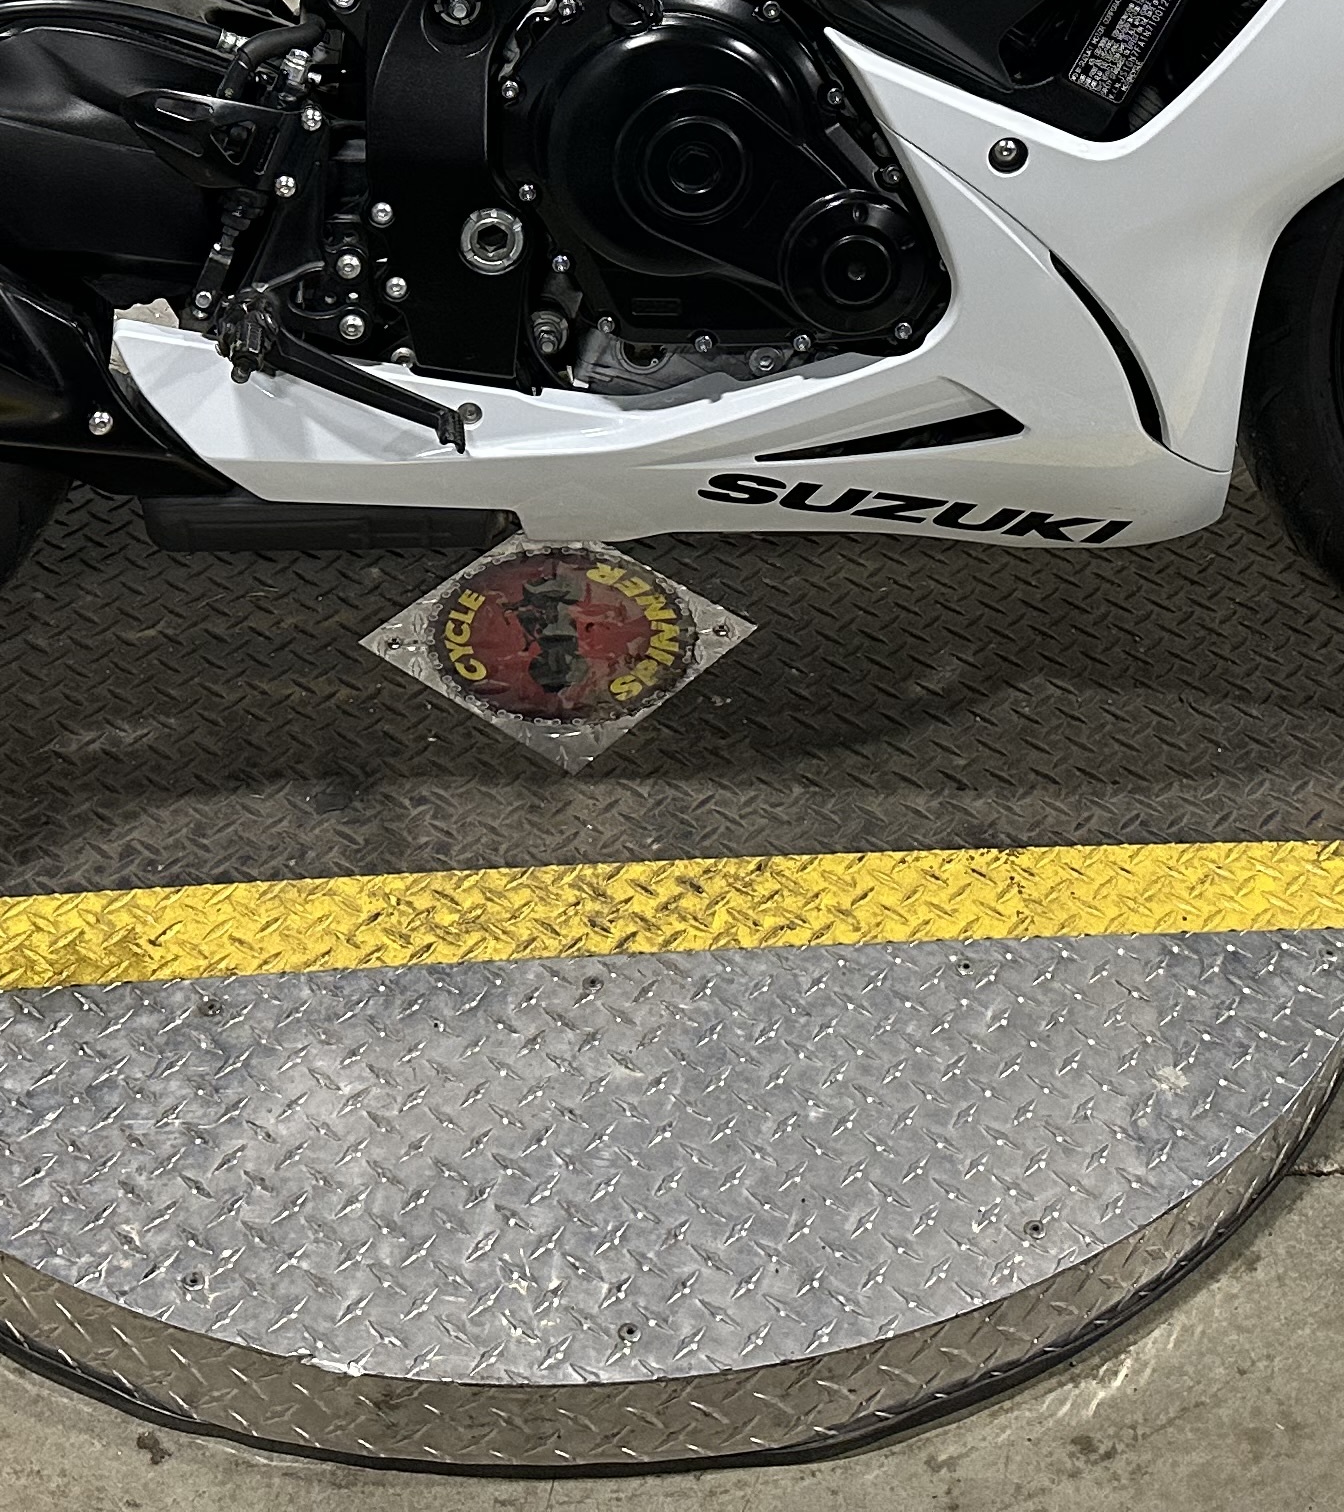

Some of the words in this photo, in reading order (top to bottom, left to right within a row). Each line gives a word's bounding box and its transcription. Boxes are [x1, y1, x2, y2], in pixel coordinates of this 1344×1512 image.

[697, 473, 1133, 545] SUZUKI
[444, 589, 487, 682] CYCLE
[586, 562, 681, 702] SPINNER
